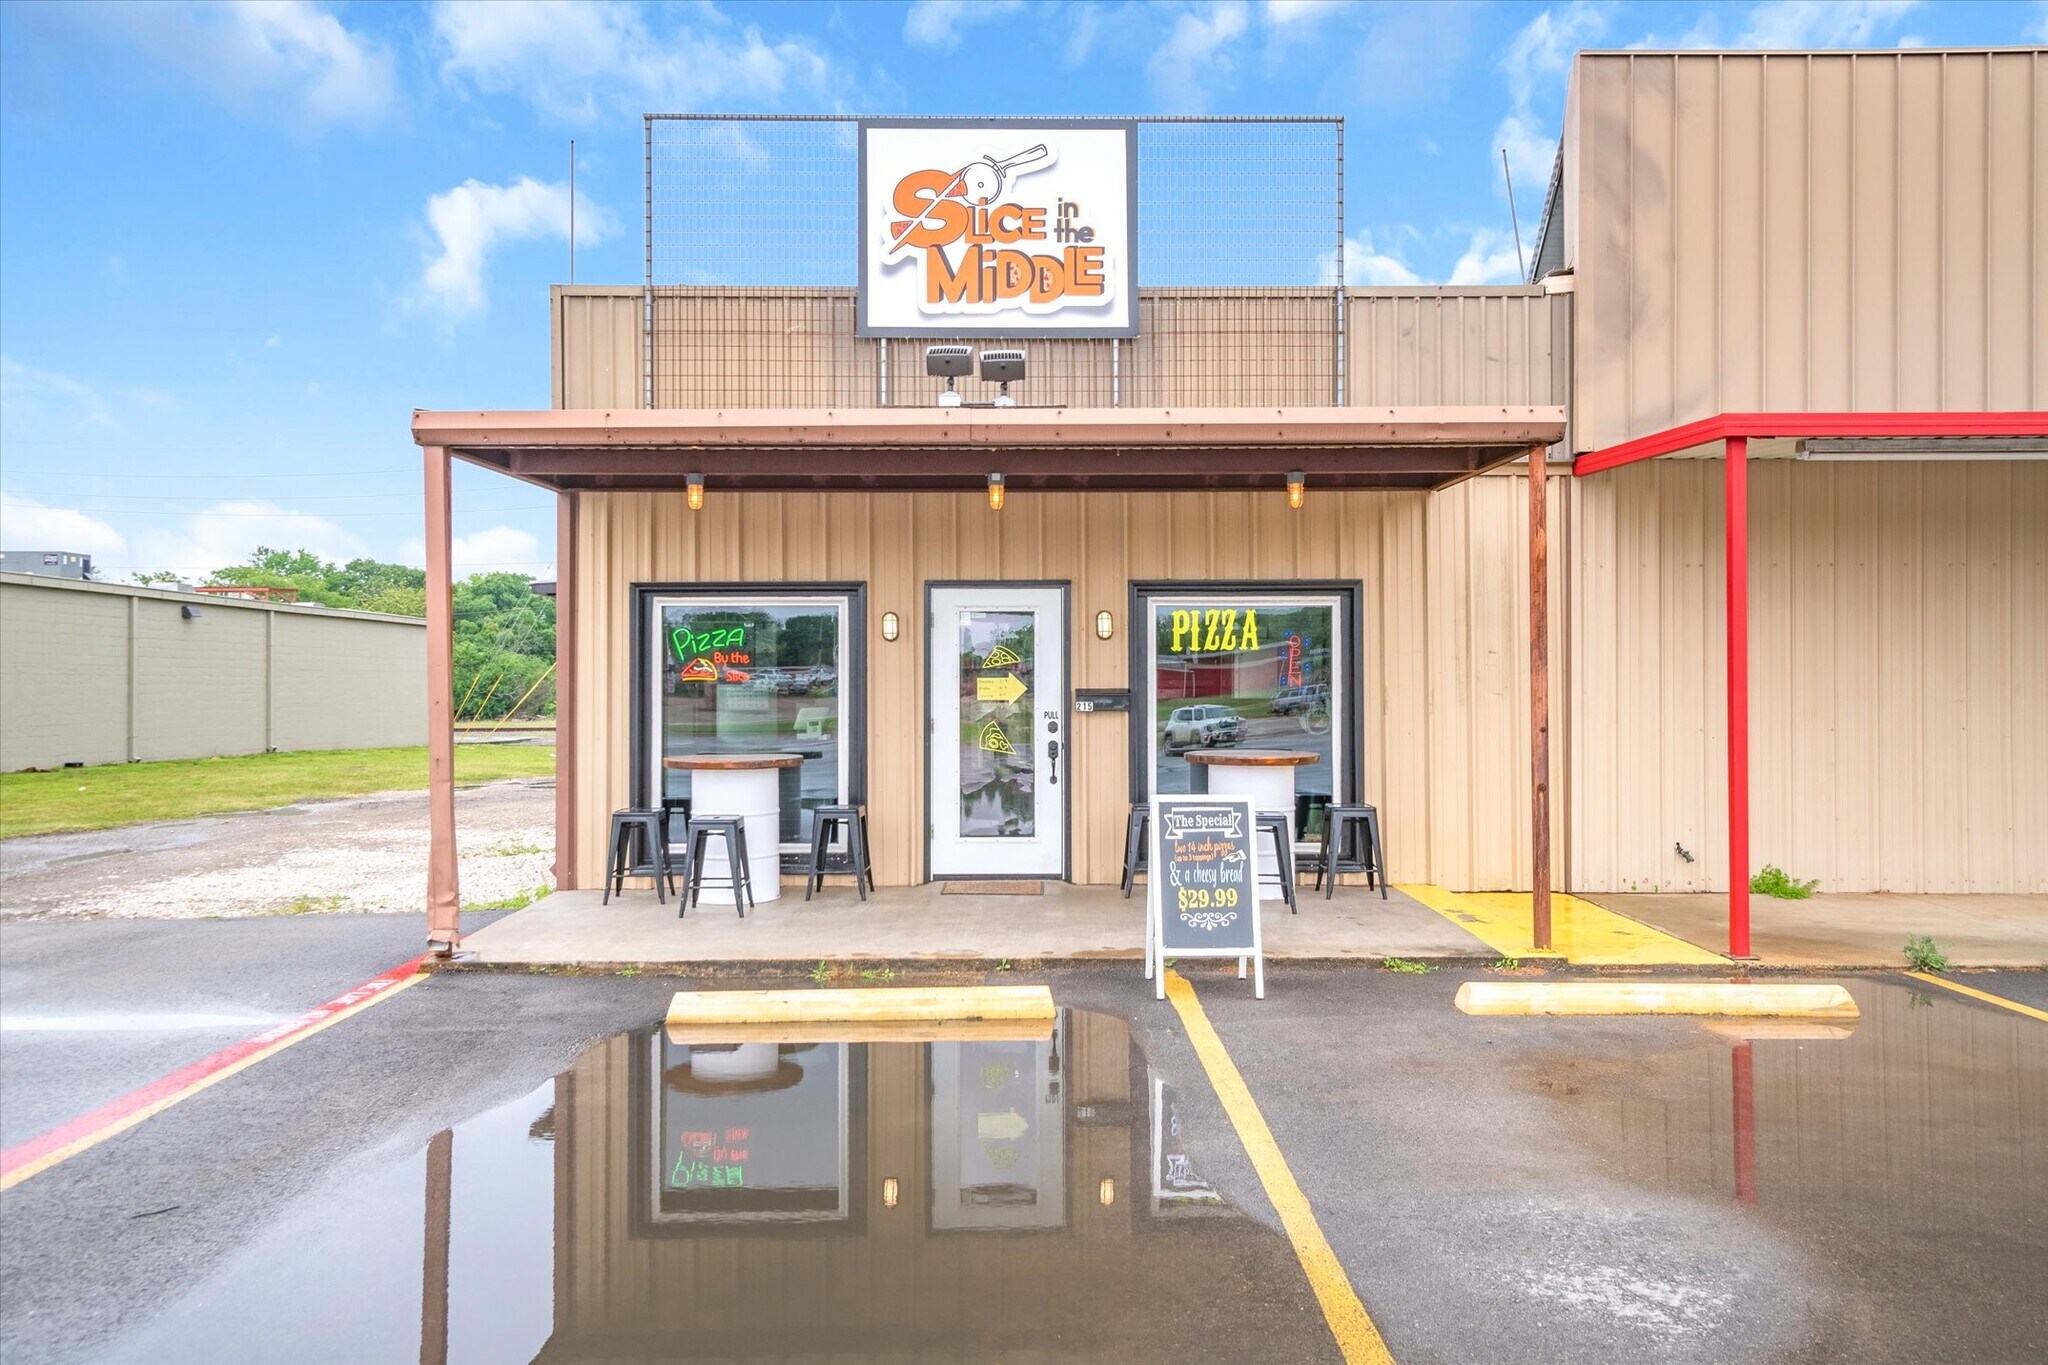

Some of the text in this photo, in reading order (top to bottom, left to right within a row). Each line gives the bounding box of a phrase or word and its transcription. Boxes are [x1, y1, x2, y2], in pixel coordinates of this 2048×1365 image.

[1058, 197, 1079, 218] in
[1054, 218, 1095, 243] the
[1170, 608, 1260, 652] PIZZA
[714, 651, 750, 666] By the
[1288, 635, 1302, 687] OPEN
[1043, 711, 1059, 720] PULL
[1076, 702, 1093, 711] 215
[1173, 813, 1232, 829] The Special
[1188, 841, 1196, 853] 14
[1198, 836, 1213, 852] inch
[1169, 860, 1244, 888] & a cheesy bread
[1178, 887, 1238, 912] $29.99
